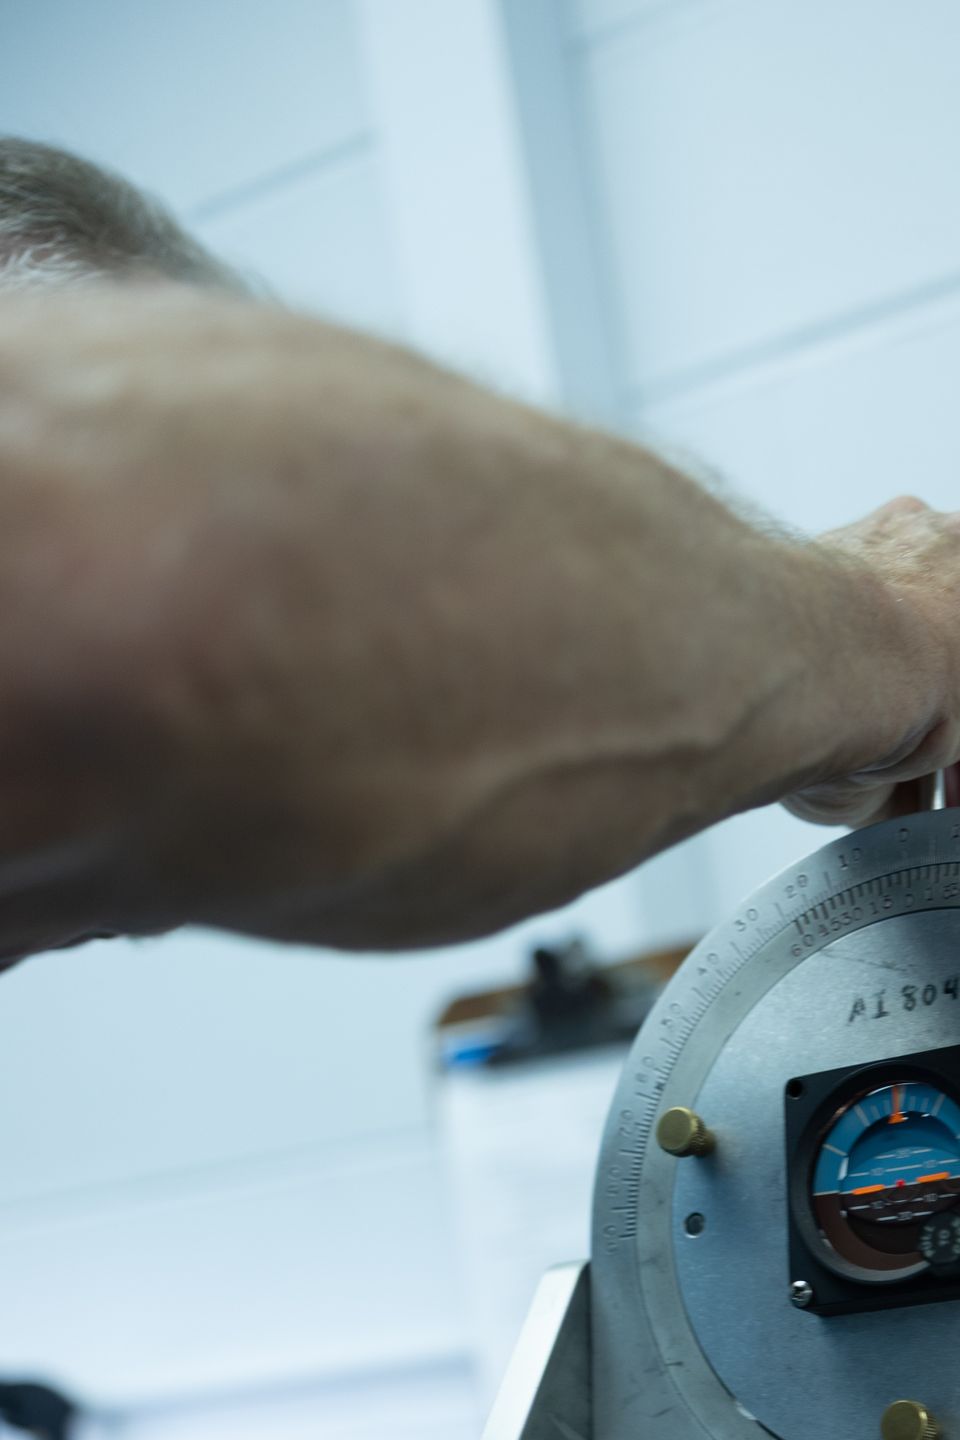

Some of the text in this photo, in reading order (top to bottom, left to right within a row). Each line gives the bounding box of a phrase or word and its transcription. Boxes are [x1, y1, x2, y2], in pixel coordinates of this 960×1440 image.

[734, 907, 758, 932] 30
[784, 874, 809, 899] 20
[838, 847, 861, 871] 10
[899, 827, 911, 844] 0
[790, 933, 815, 957] 60
[871, 896, 894, 915] 15
[904, 893, 916, 909] 0
[902, 977, 960, 1011] 804
